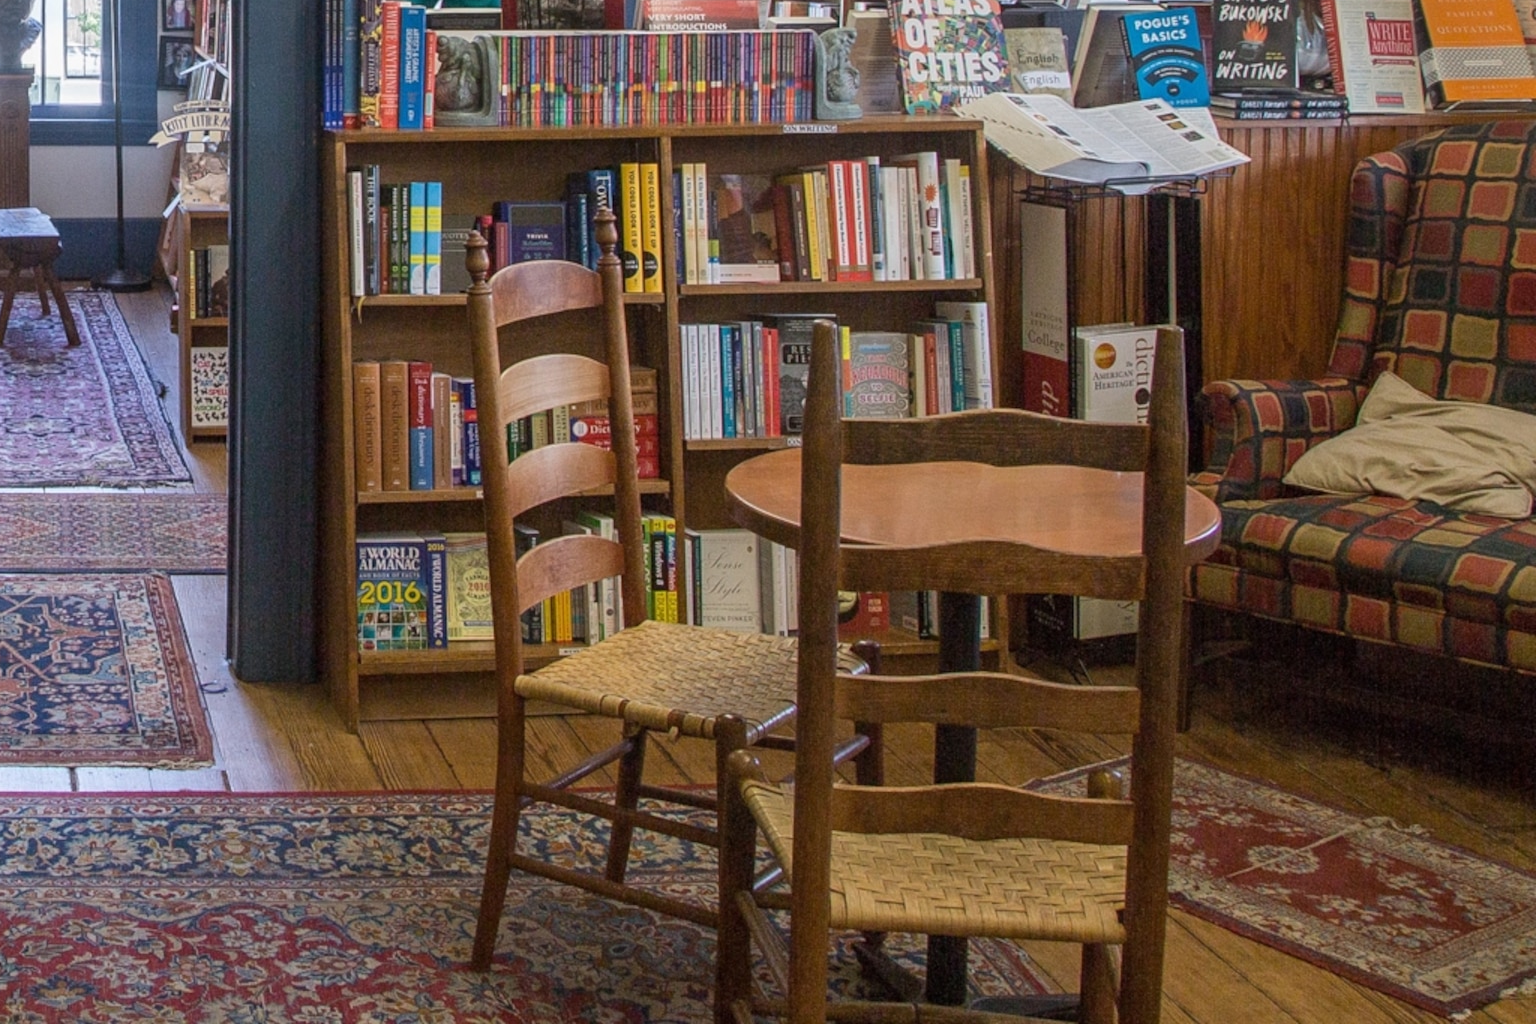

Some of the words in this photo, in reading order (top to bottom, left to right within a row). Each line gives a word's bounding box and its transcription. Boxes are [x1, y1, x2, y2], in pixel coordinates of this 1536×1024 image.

[647, 13, 672, 21] VERY
[674, 13, 706, 21] SHORT
[1133, 15, 1190, 31] POGUE'S
[1218, 4, 1290, 24] BUKOWSKI
[1446, 10, 1494, 18] FAMILIAR
[648, 22, 728, 31] INTRODUCTIONS
[904, 18, 941, 48] OF
[1368, 22, 1410, 41] WRITE
[1436, 24, 1514, 35] QUOTATIONS
[1141, 29, 1188, 44] BASICS
[1218, 49, 1236, 61] ON
[1370, 40, 1413, 55] Anything
[908, 51, 1000, 82] CITIES
[1016, 49, 1060, 66] English
[386, 44, 399, 94] ANYTHING
[404, 60, 412, 84] MARKET
[1215, 62, 1288, 80] WRITING
[1022, 75, 1061, 88] English
[785, 125, 799, 133] ON
[799, 125, 837, 133] WRITING
[367, 175, 376, 194] THE
[367, 195, 376, 224] BOOK
[631, 238, 638, 248] UP
[650, 238, 657, 248] UP
[1027, 330, 1064, 354] College
[1093, 370, 1133, 381] AMERICAN
[1094, 381, 1133, 390] HERITAGE
[365, 386, 375, 410] desk
[392, 385, 401, 410] desk
[417, 385, 427, 423] dictionary
[857, 394, 896, 404] SELFIE
[364, 411, 376, 465] dictionary
[390, 410, 402, 465] dictionary
[367, 546, 420, 559] WORLD
[427, 543, 445, 552] 2016
[359, 558, 421, 571] ALMANAC
[654, 540, 664, 574] Windows
[432, 558, 442, 591] WORLD
[360, 580, 422, 604] 2016
[706, 577, 742, 600] Style
[432, 592, 444, 638] ALMANAC
